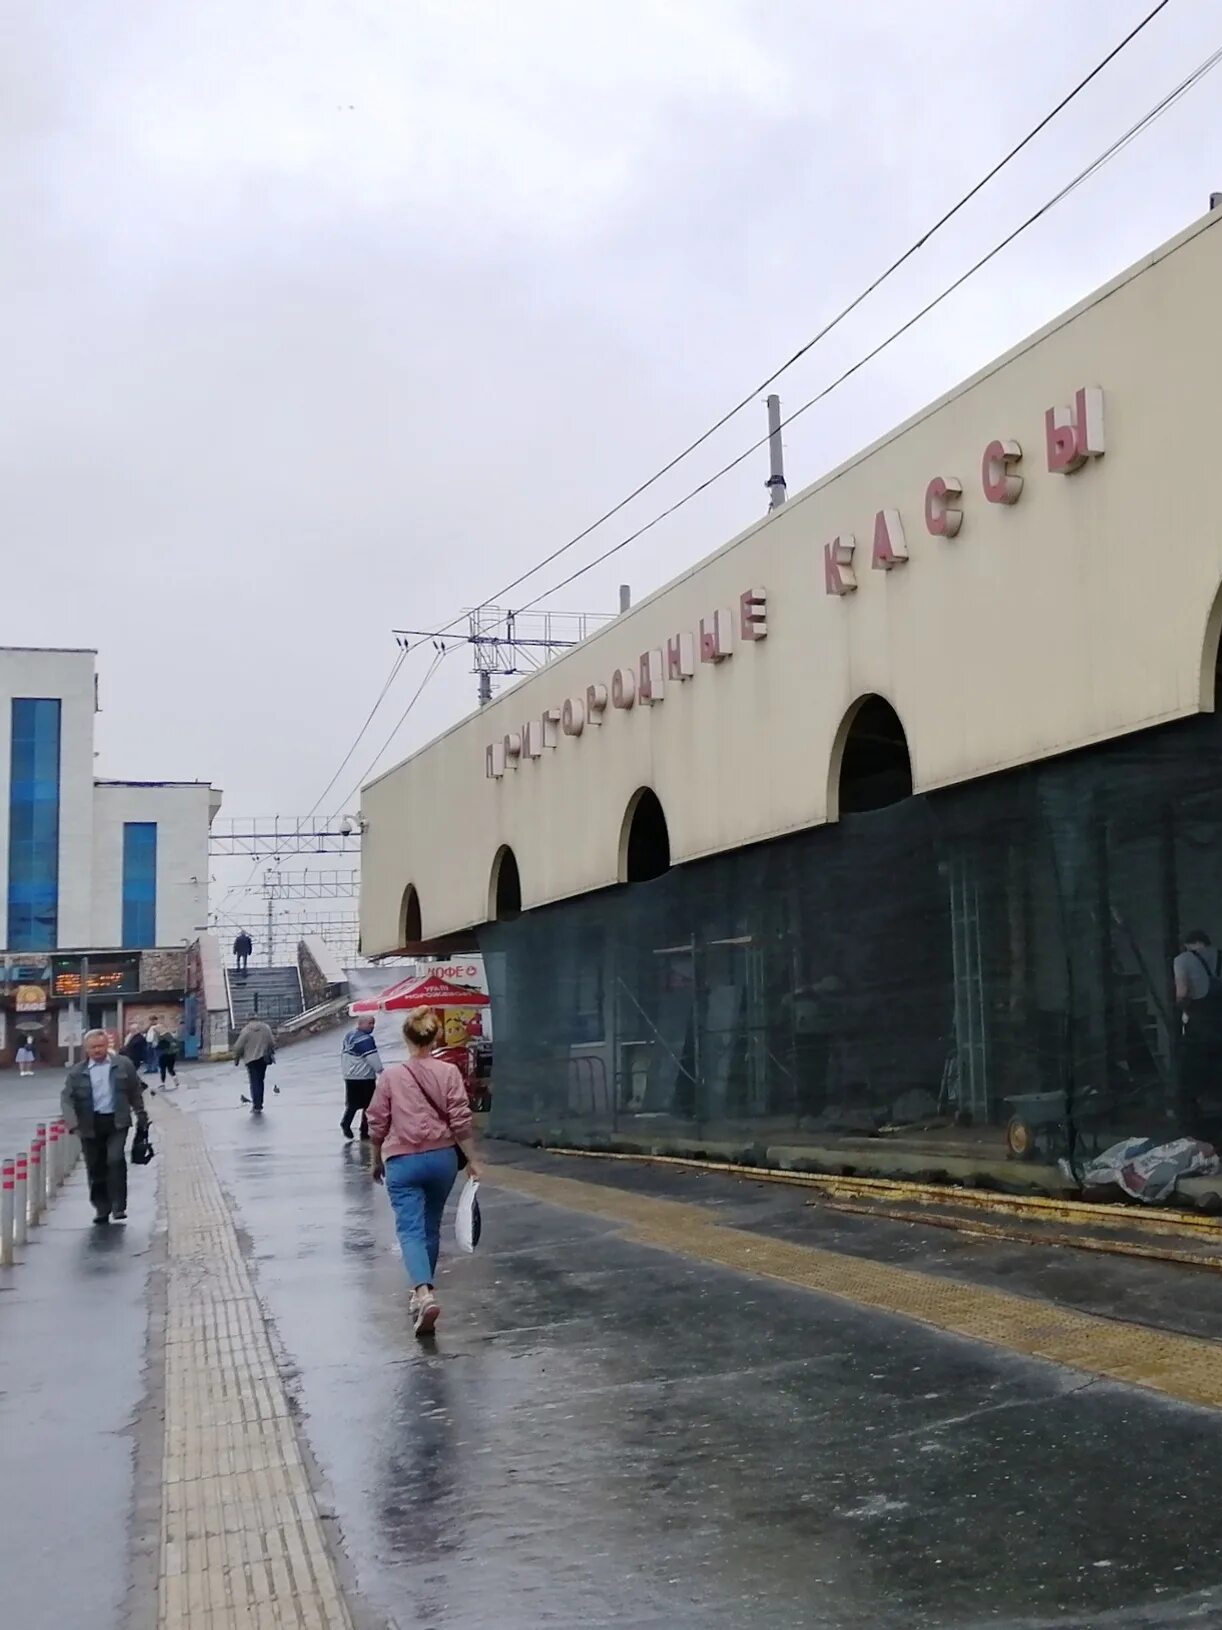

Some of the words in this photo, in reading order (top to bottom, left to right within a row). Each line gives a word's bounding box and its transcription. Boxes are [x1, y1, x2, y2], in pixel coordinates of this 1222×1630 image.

[486, 587, 768, 779] ПРИГОРОДНЫЕ
[824, 386, 1105, 596] КАССЫ
[427, 965, 464, 979] КОФЕ
